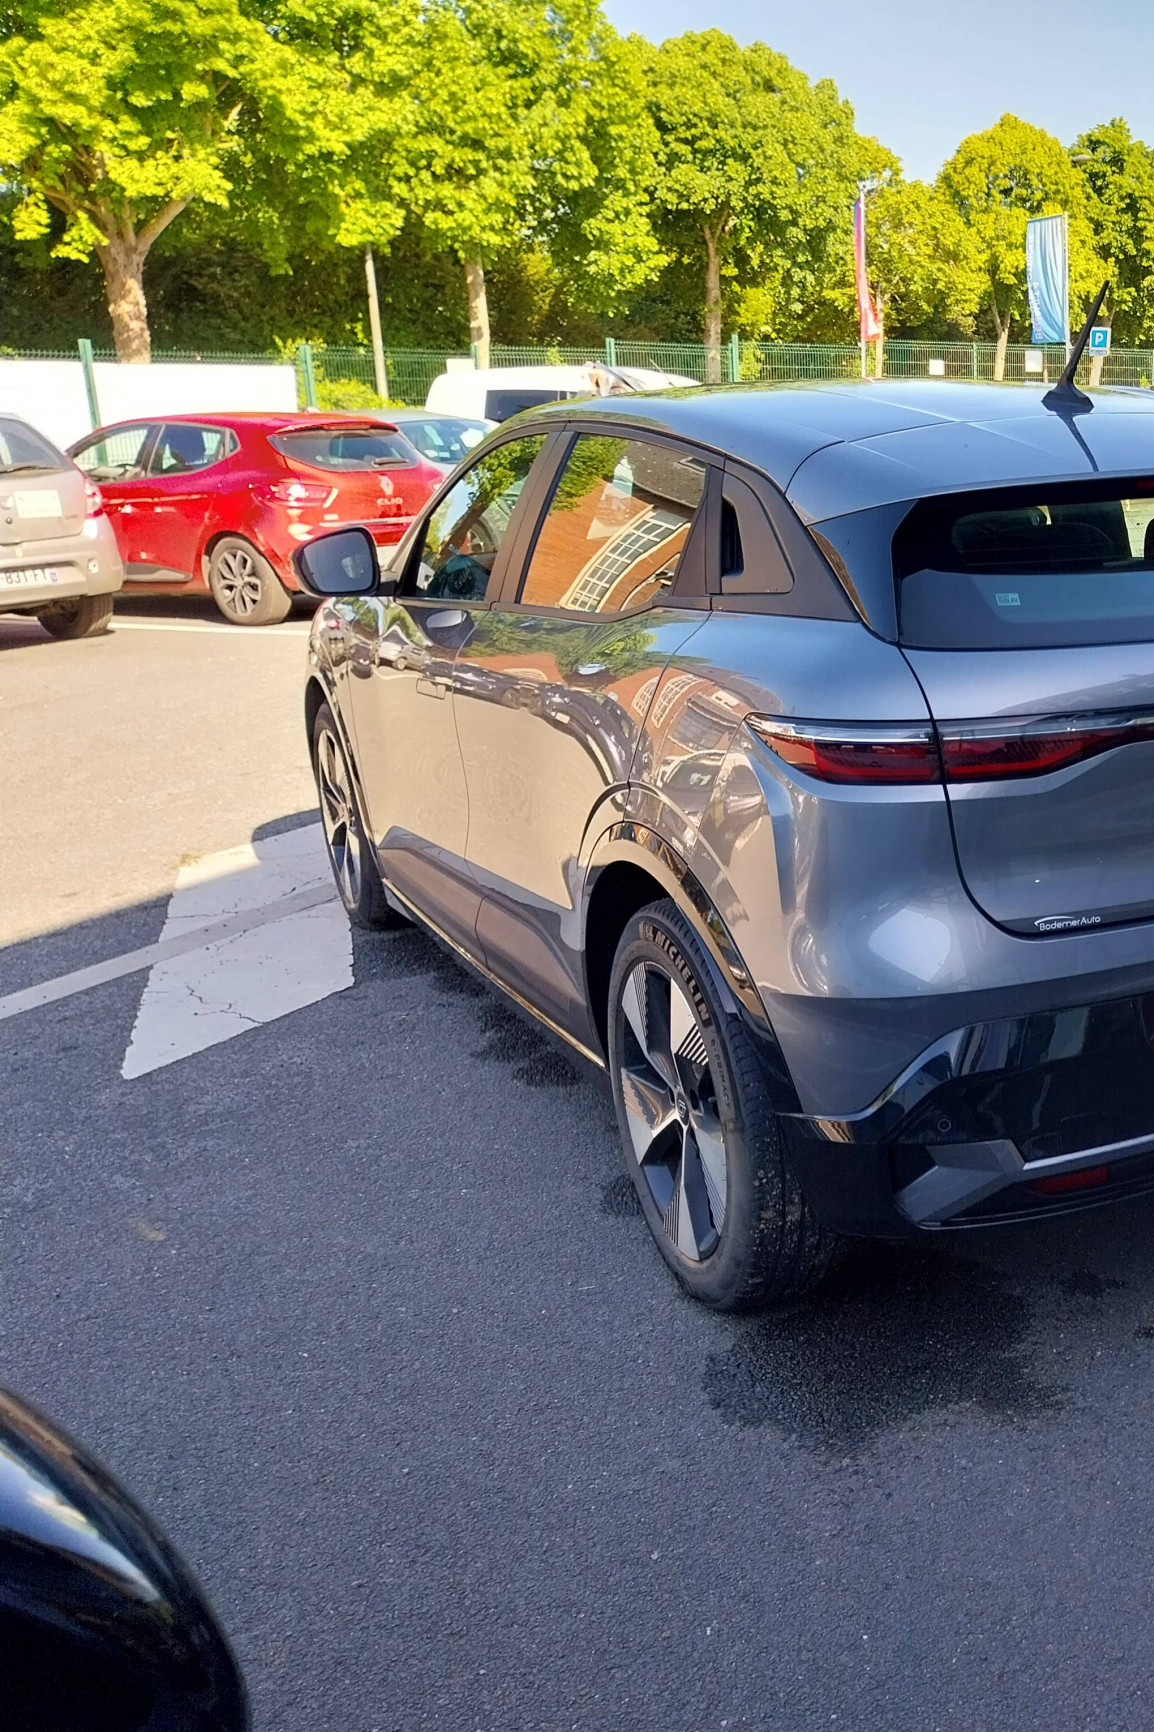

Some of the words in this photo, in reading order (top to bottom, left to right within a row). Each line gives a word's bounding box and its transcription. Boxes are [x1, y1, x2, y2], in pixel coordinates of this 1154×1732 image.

[1094, 332, 1104, 346] P
[376, 497, 403, 506] CLIO
[1039, 915, 1101, 931] BodemerAuto
[655, 930, 710, 1021] MICHELIN
